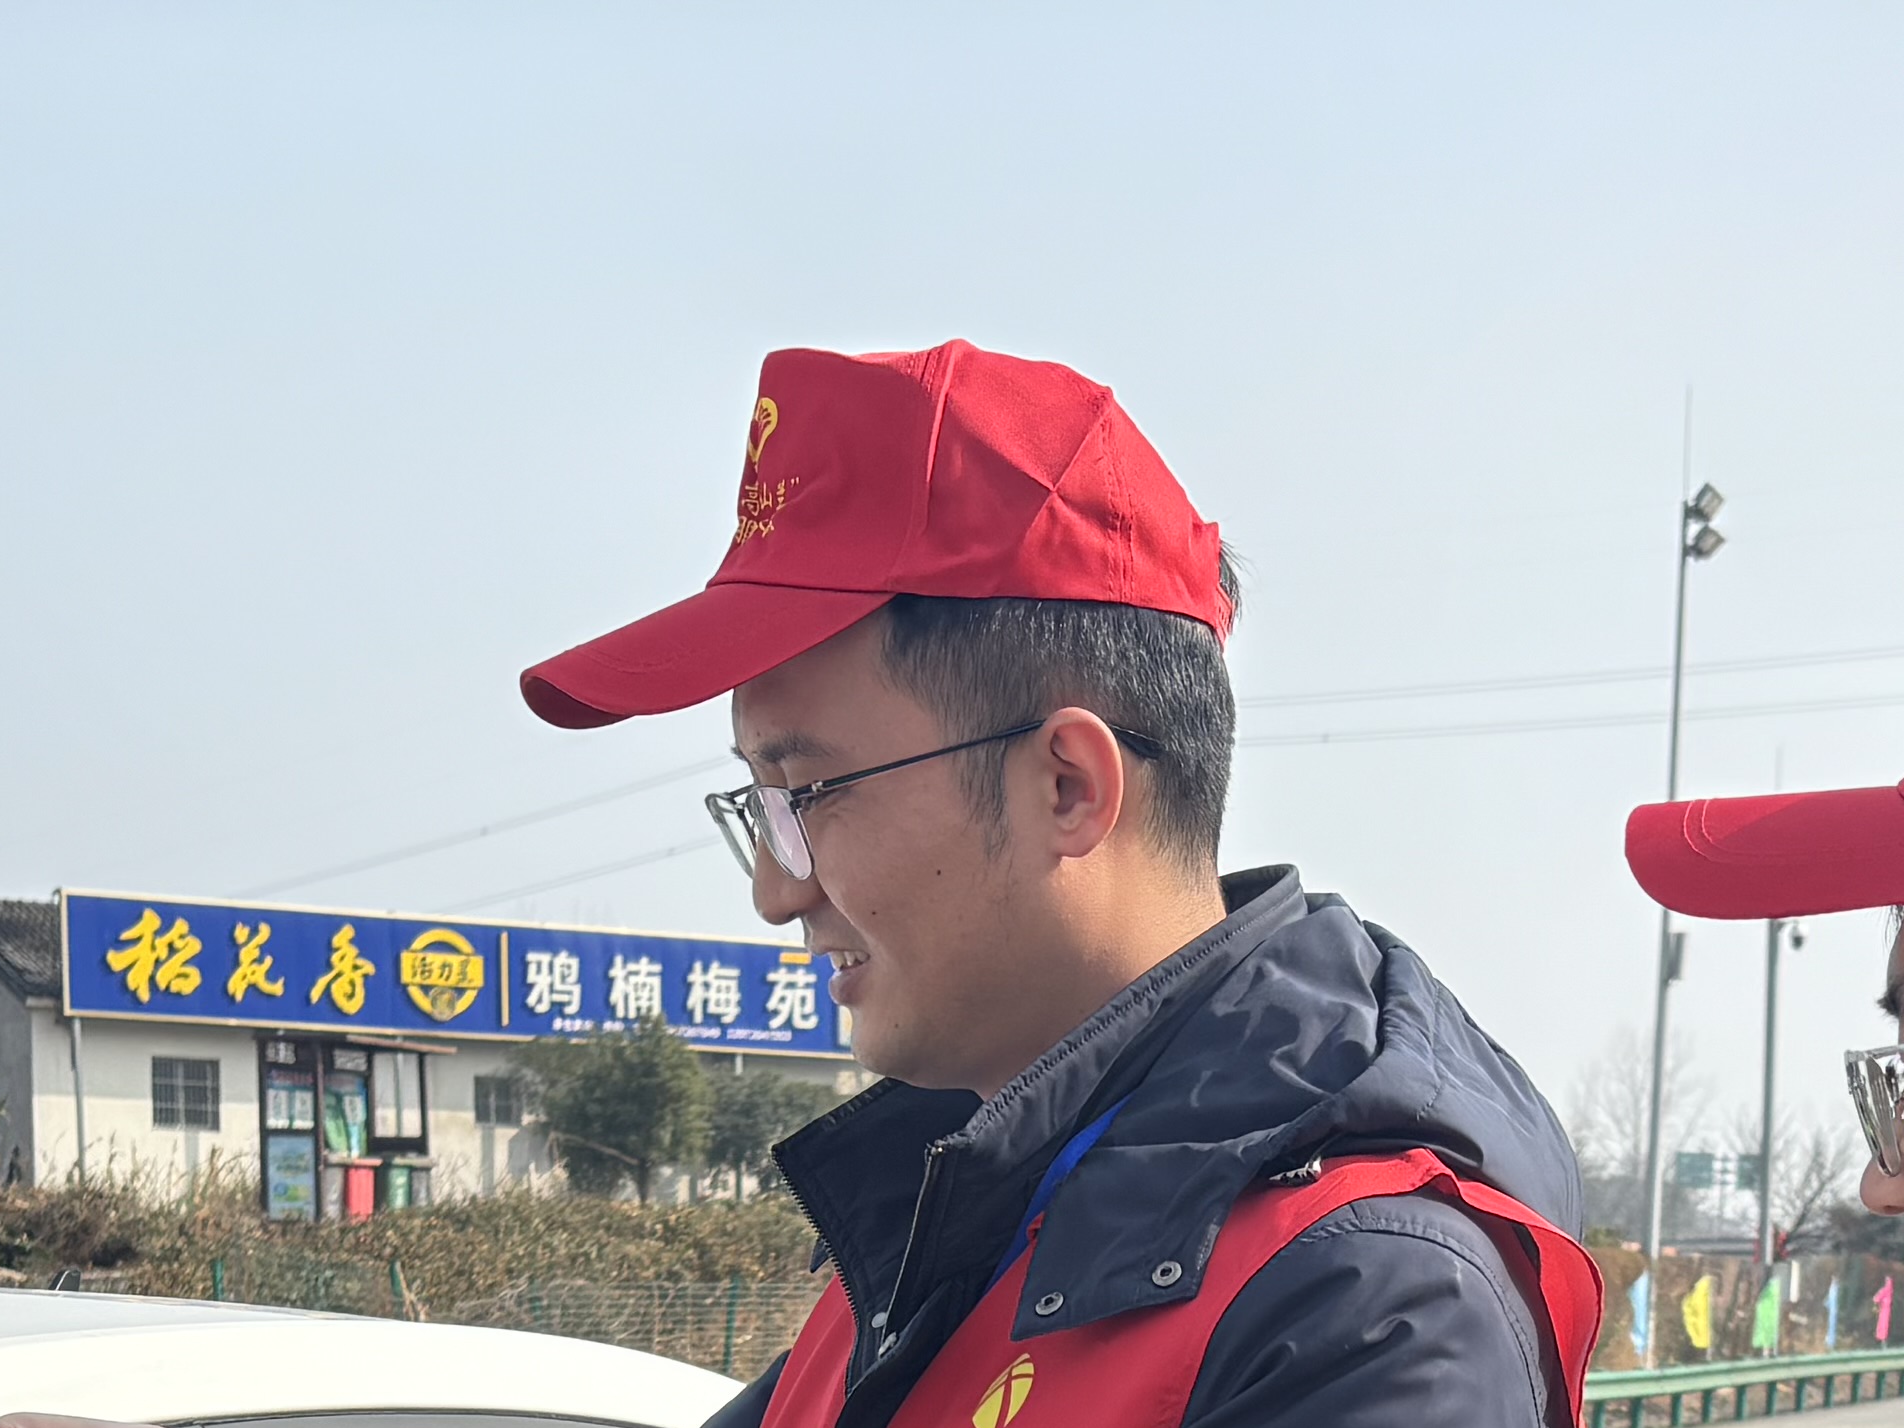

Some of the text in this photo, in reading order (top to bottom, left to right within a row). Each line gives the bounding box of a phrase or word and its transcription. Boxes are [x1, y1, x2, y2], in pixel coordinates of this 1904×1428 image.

[106, 908, 376, 1016] 稻花香
[525, 949, 819, 1030] 鸦楠梅苑
